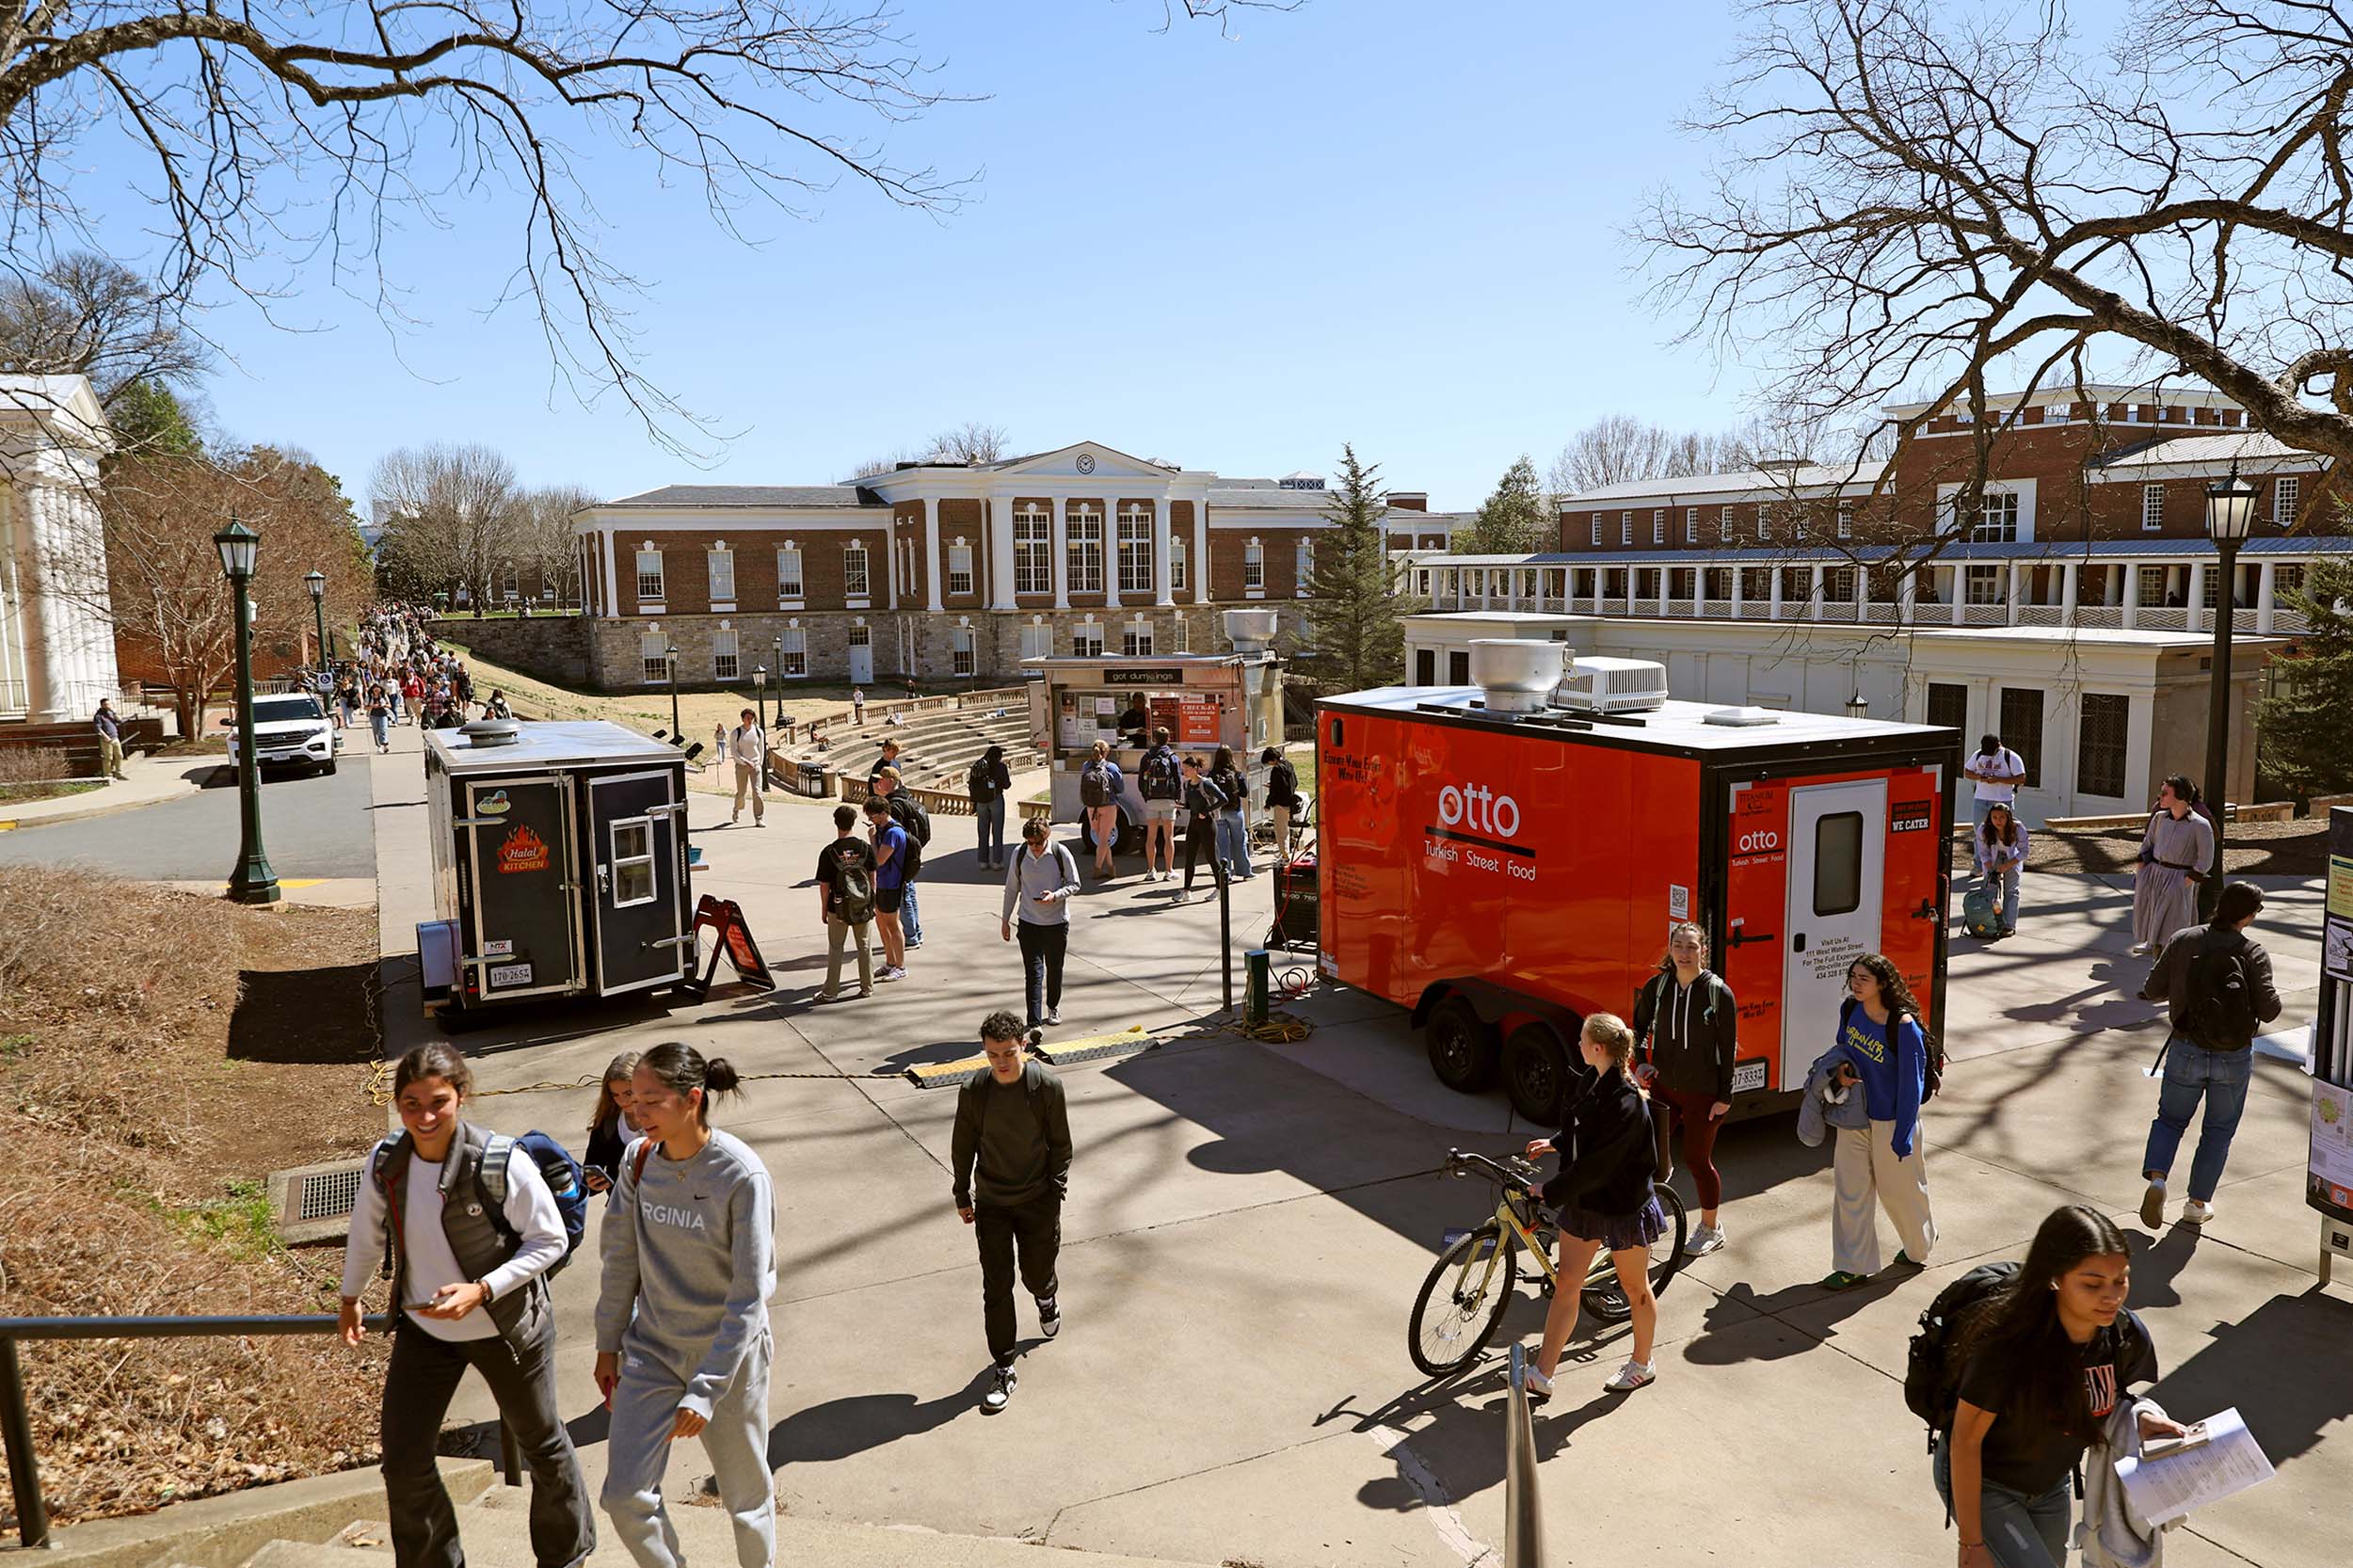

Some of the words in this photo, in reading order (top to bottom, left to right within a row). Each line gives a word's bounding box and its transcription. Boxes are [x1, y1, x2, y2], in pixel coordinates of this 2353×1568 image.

[1112, 673, 1127, 681] got
[1438, 782, 1520, 838] otto
[1893, 821, 1904, 831] WE
[1905, 819, 1929, 830] CATER
[1739, 830, 1778, 852] otto
[509, 846, 536, 858] Halal
[1770, 854, 1785, 862] Food
[504, 860, 544, 872] KITCHEN
[1424, 840, 1459, 862] Turkish
[1466, 850, 1499, 872] Street
[1507, 859, 1536, 881] Food
[1847, 942, 1864, 951] Street
